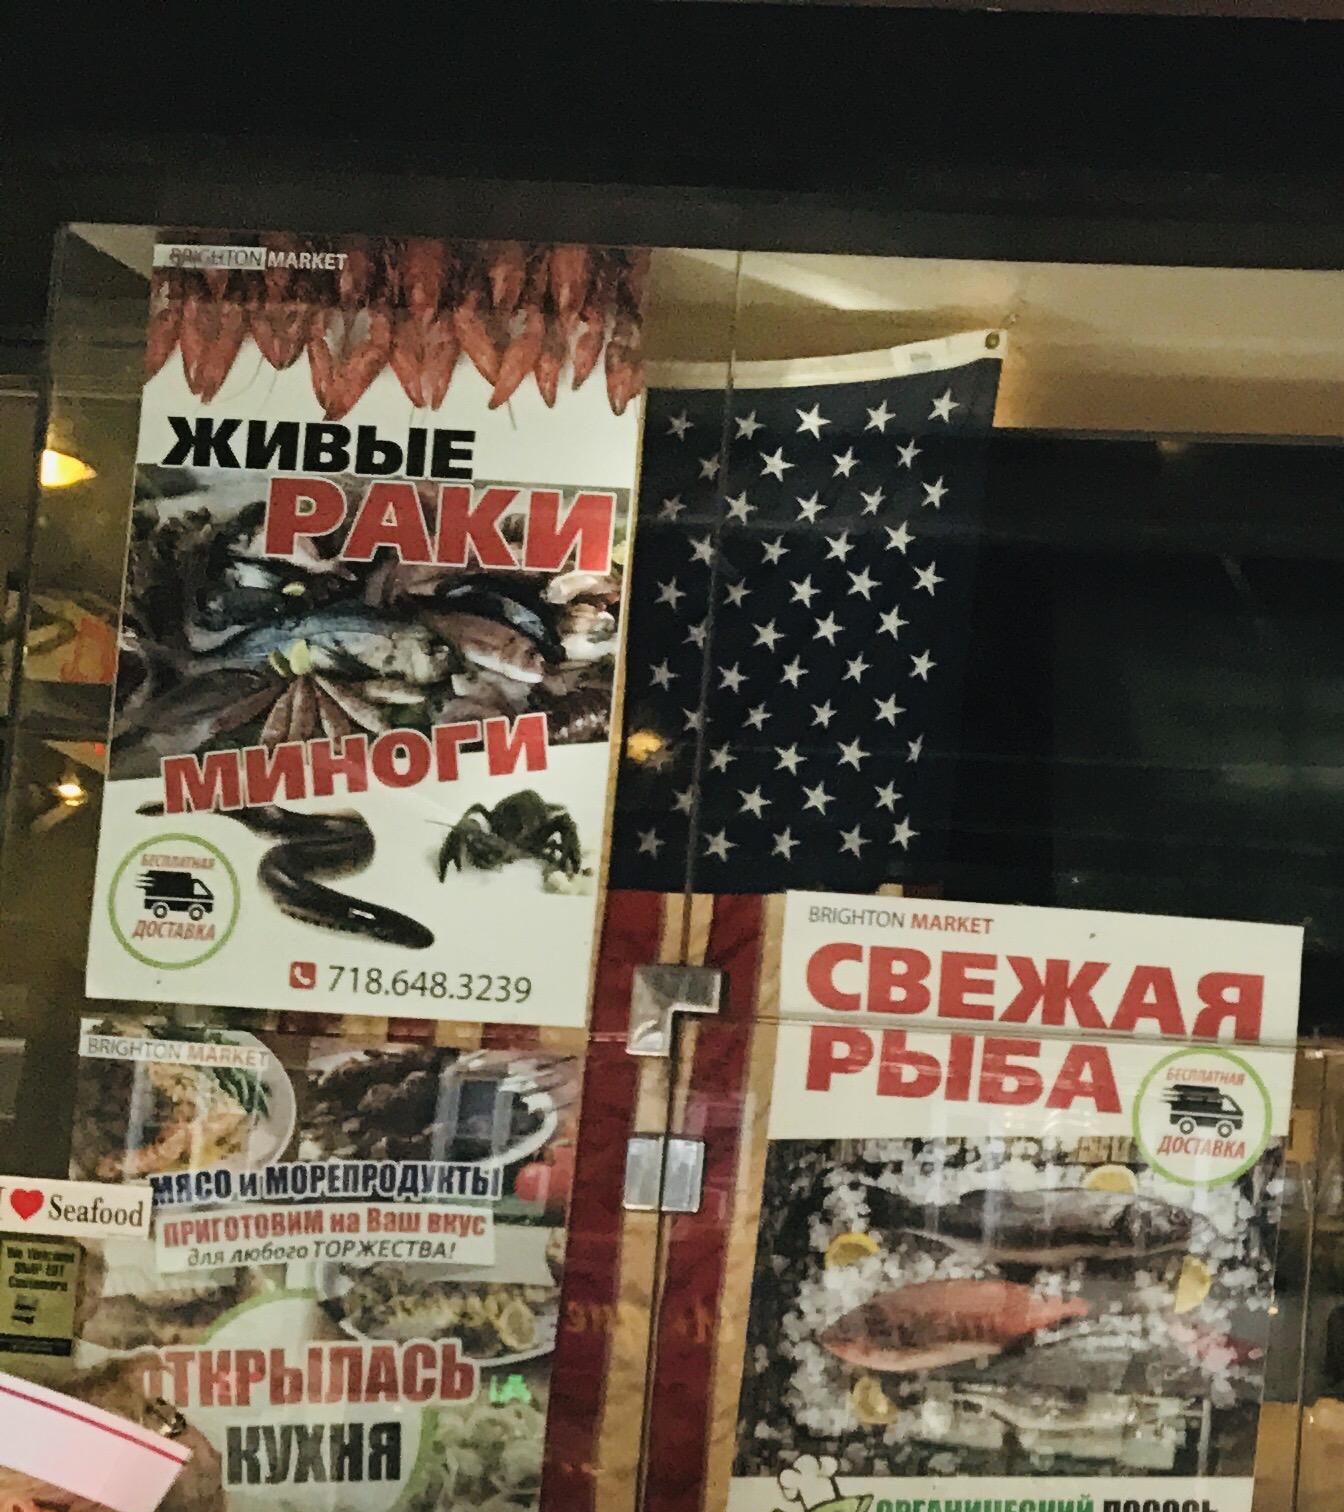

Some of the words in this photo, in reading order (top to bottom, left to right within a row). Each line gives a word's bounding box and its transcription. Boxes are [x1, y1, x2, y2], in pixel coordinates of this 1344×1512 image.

[267, 251, 348, 271] MARKET
[161, 415, 477, 480] ЖИВЫЕ
[264, 476, 614, 576] РАКИ
[160, 713, 548, 815] МИНОГИ
[131, 919, 217, 942] ДОСТАВКА
[807, 906, 905, 929] BRIGHTON
[911, 913, 995, 935] MARKET
[327, 965, 533, 1005] 718.648.3239
[805, 942, 1266, 1042] СВЕЖАЯ
[87, 1036, 182, 1061] BRIGHTON
[187, 1044, 270, 1068] MARKET
[805, 1024, 1123, 1115] РЫБА
[1156, 1135, 1247, 1160] ДОСТАВКА
[48, 1194, 144, 1228] Seafood
[163, 1209, 324, 1248] ПРИГОТОВИМ
[330, 1211, 360, 1234] на
[366, 1207, 421, 1234] Ваш
[187, 1249, 225, 1267] для
[229, 1242, 309, 1262] любого
[310, 1240, 456, 1260] ТОРЖЕСТВА!
[226, 1421, 402, 1485] КУХНЯ
